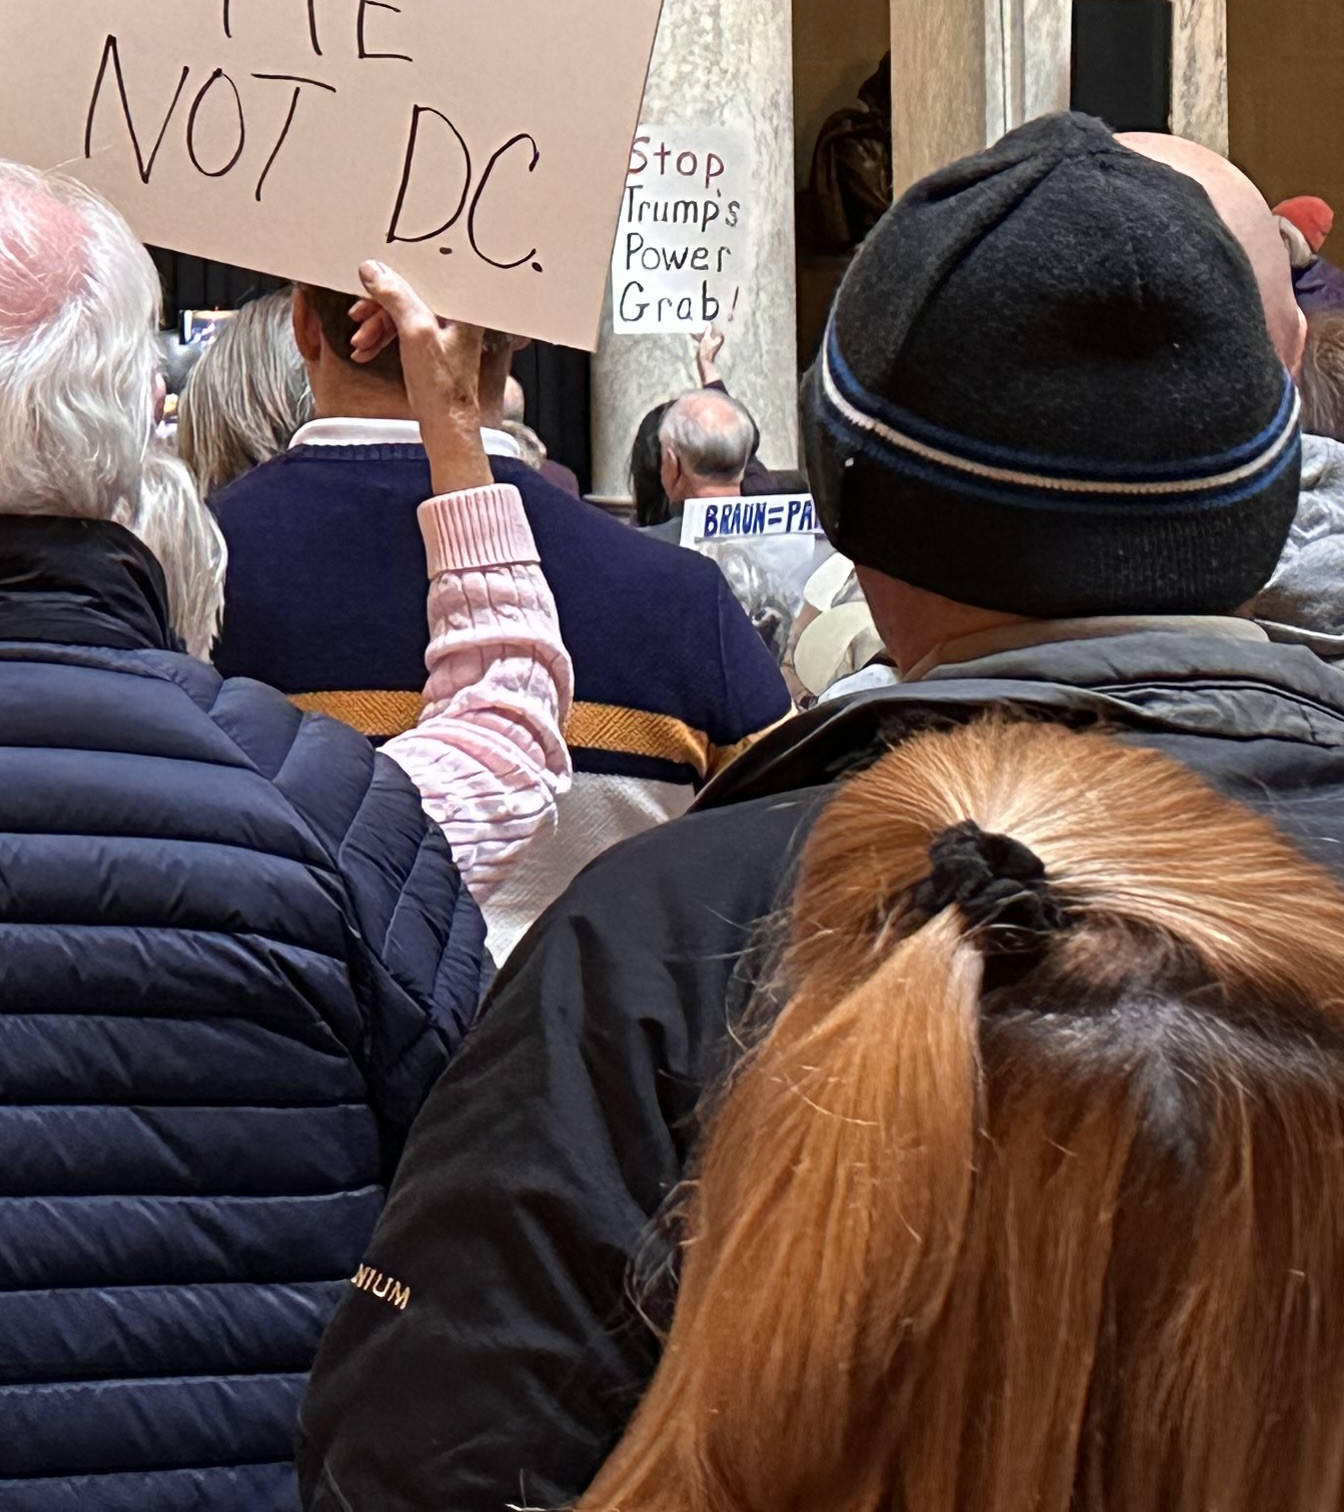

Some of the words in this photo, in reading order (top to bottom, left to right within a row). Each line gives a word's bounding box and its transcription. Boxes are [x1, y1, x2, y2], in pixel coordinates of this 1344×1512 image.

[85, 35, 336, 201] NOT
[386, 104, 543, 273] D.C.
[628, 136, 724, 188] Stop
[626, 184, 740, 232] Trump's
[626, 232, 731, 272] Power
